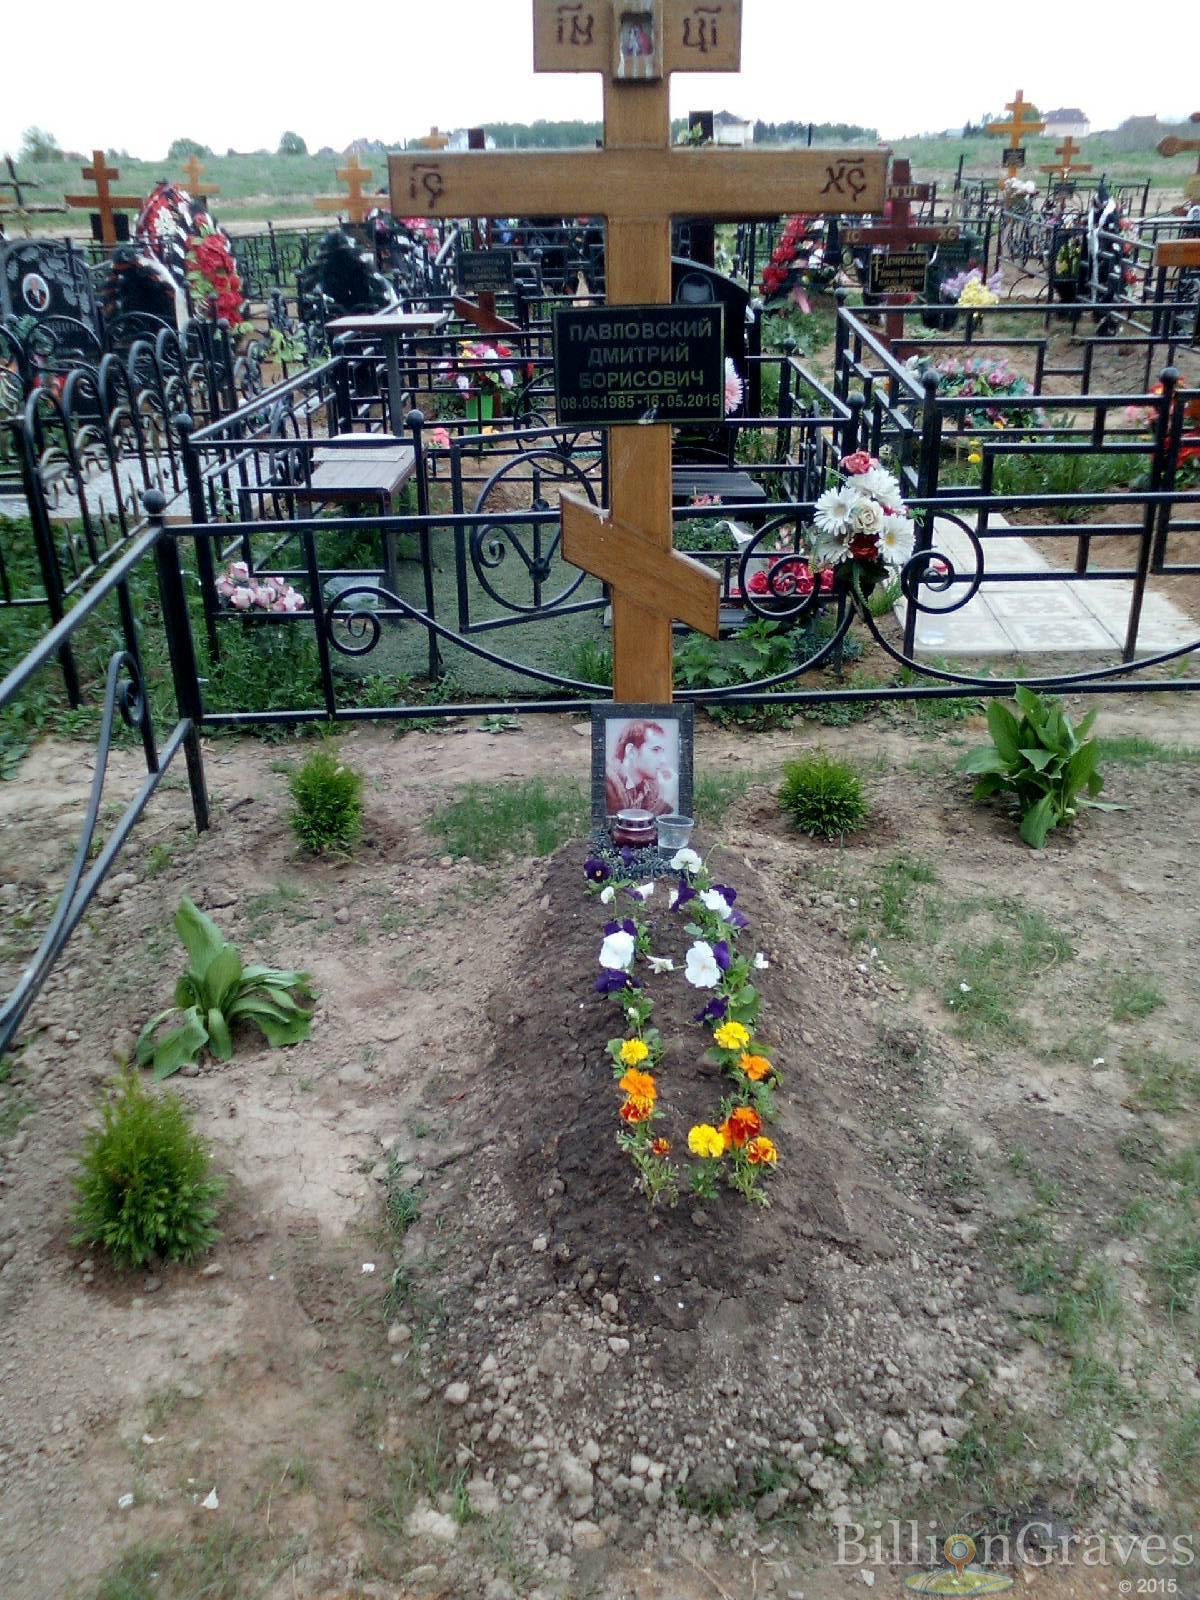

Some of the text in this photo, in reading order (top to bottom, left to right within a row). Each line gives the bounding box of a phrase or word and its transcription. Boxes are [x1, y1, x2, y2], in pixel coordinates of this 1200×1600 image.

[569, 318, 712, 341] ПАВЛОВСКИЙ
[587, 342, 690, 368] ДМИТРИЙ
[578, 369, 705, 390] БОРИСОВИЧ
